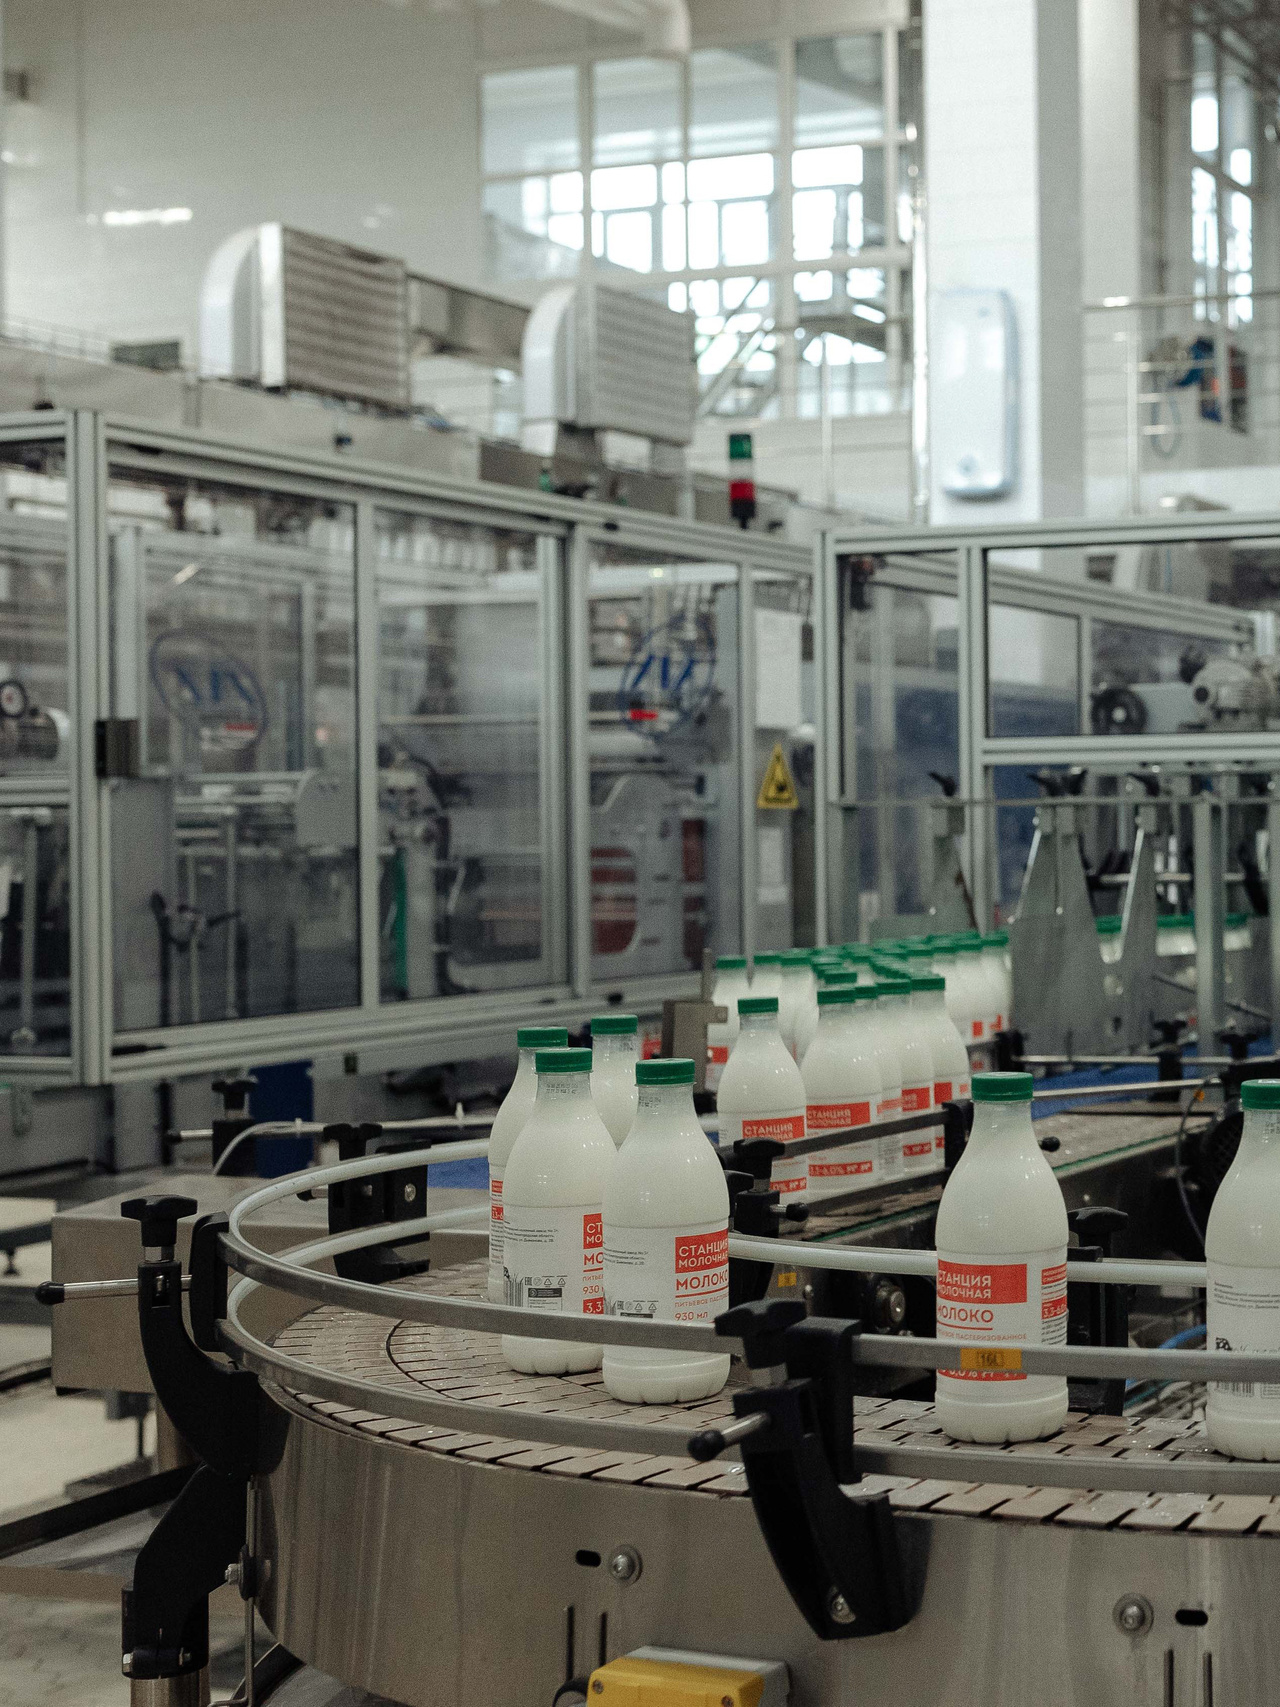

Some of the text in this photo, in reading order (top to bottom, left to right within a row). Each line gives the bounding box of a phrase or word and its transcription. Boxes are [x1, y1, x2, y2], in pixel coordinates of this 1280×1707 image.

[744, 1123, 793, 1135] СТАНЦИЯ
[582, 1285, 600, 1295] 930
[675, 1311, 708, 1321] 930 мл
